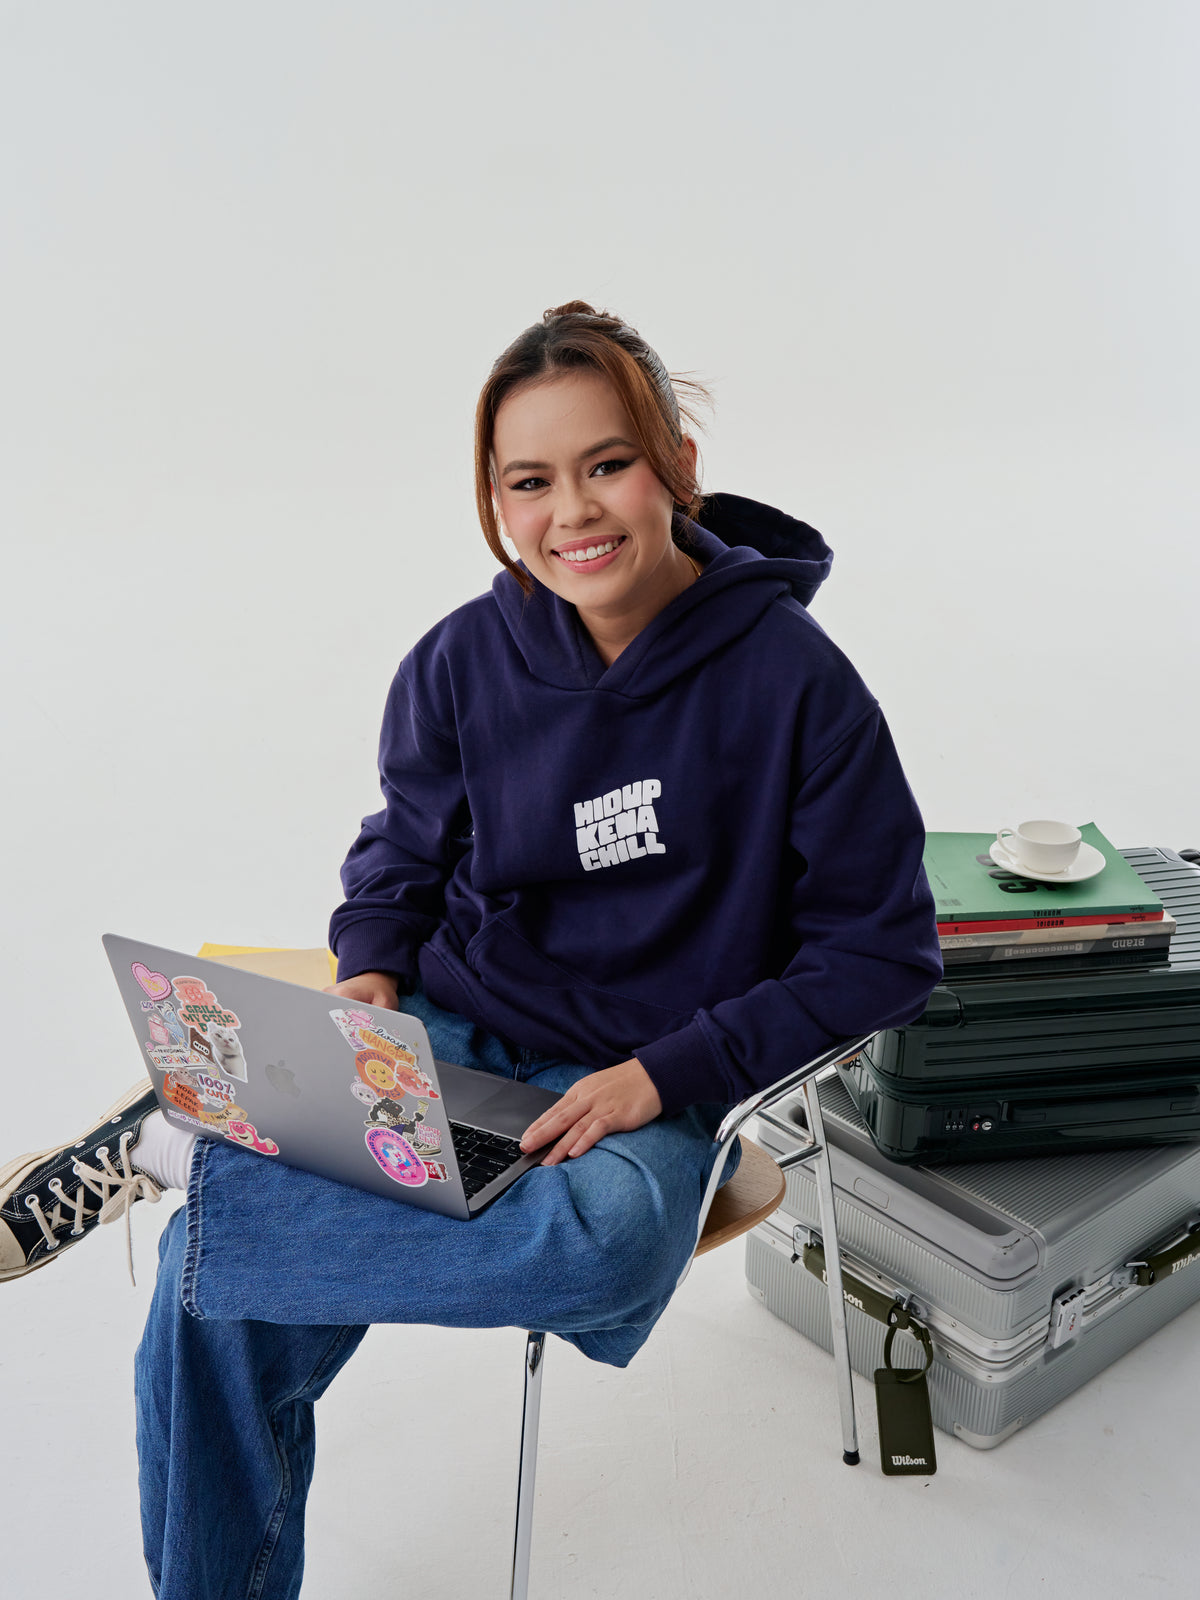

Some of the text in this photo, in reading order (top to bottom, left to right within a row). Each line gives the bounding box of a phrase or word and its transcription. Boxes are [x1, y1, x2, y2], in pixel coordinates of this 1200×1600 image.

[574, 779, 661, 827] HIDUP
[576, 805, 659, 854] KENA
[580, 832, 666, 871] CHILL
[185, 1005, 222, 1014] GRILL
[361, 1031, 413, 1064] HANGRY
[357, 1052, 393, 1066] POSITIVE
[199, 1074, 234, 1094] 100%
[375, 1086, 401, 1099] VIBES
[891, 1454, 928, 1466] Wilson
